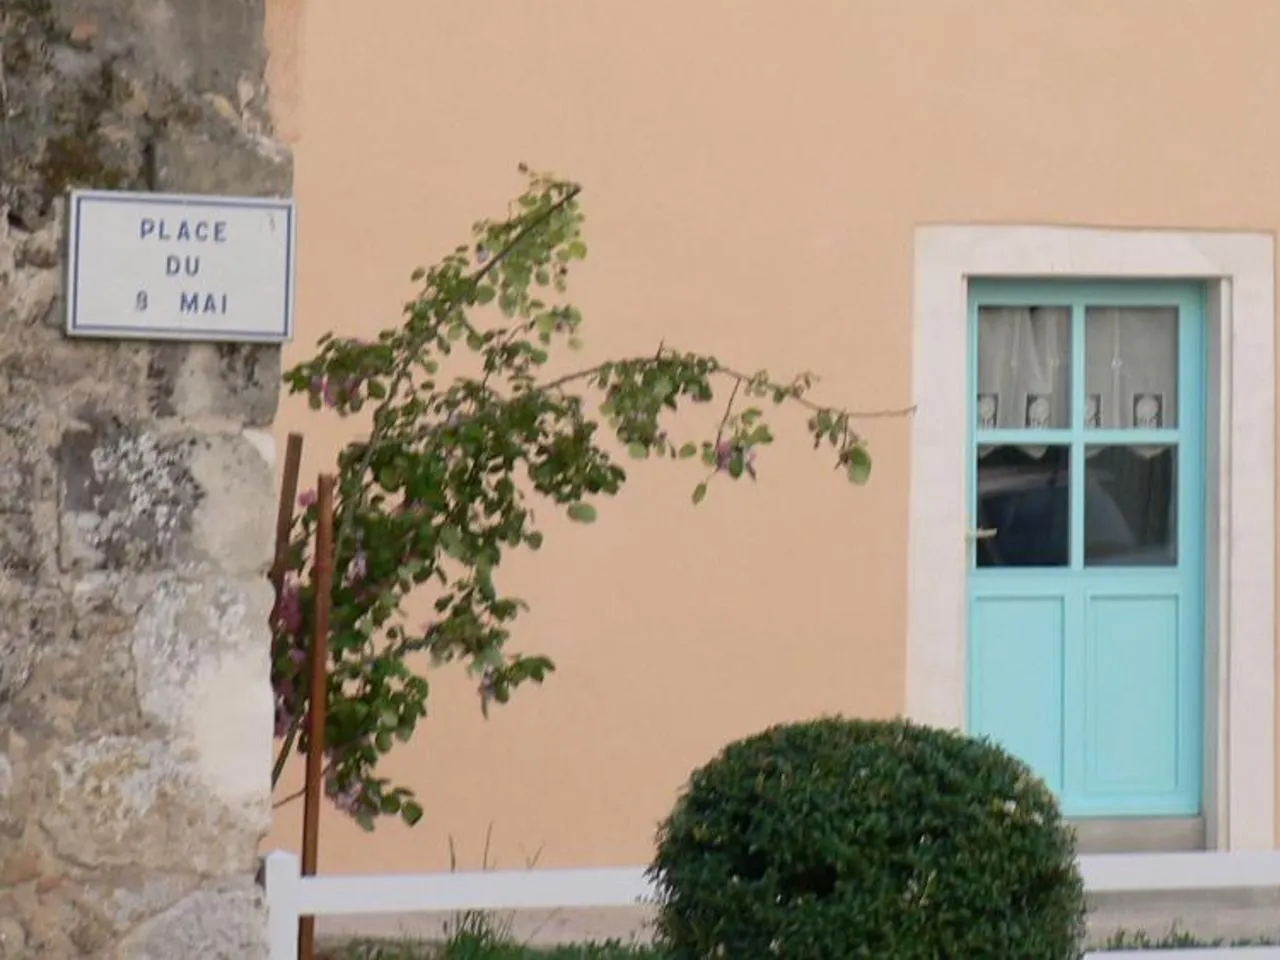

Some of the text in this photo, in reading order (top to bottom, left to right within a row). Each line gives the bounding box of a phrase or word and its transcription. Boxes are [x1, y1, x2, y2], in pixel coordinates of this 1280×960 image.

[140, 218, 228, 243] PLACE
[165, 254, 201, 277] DU
[135, 290, 228, 315] 8 MAI
